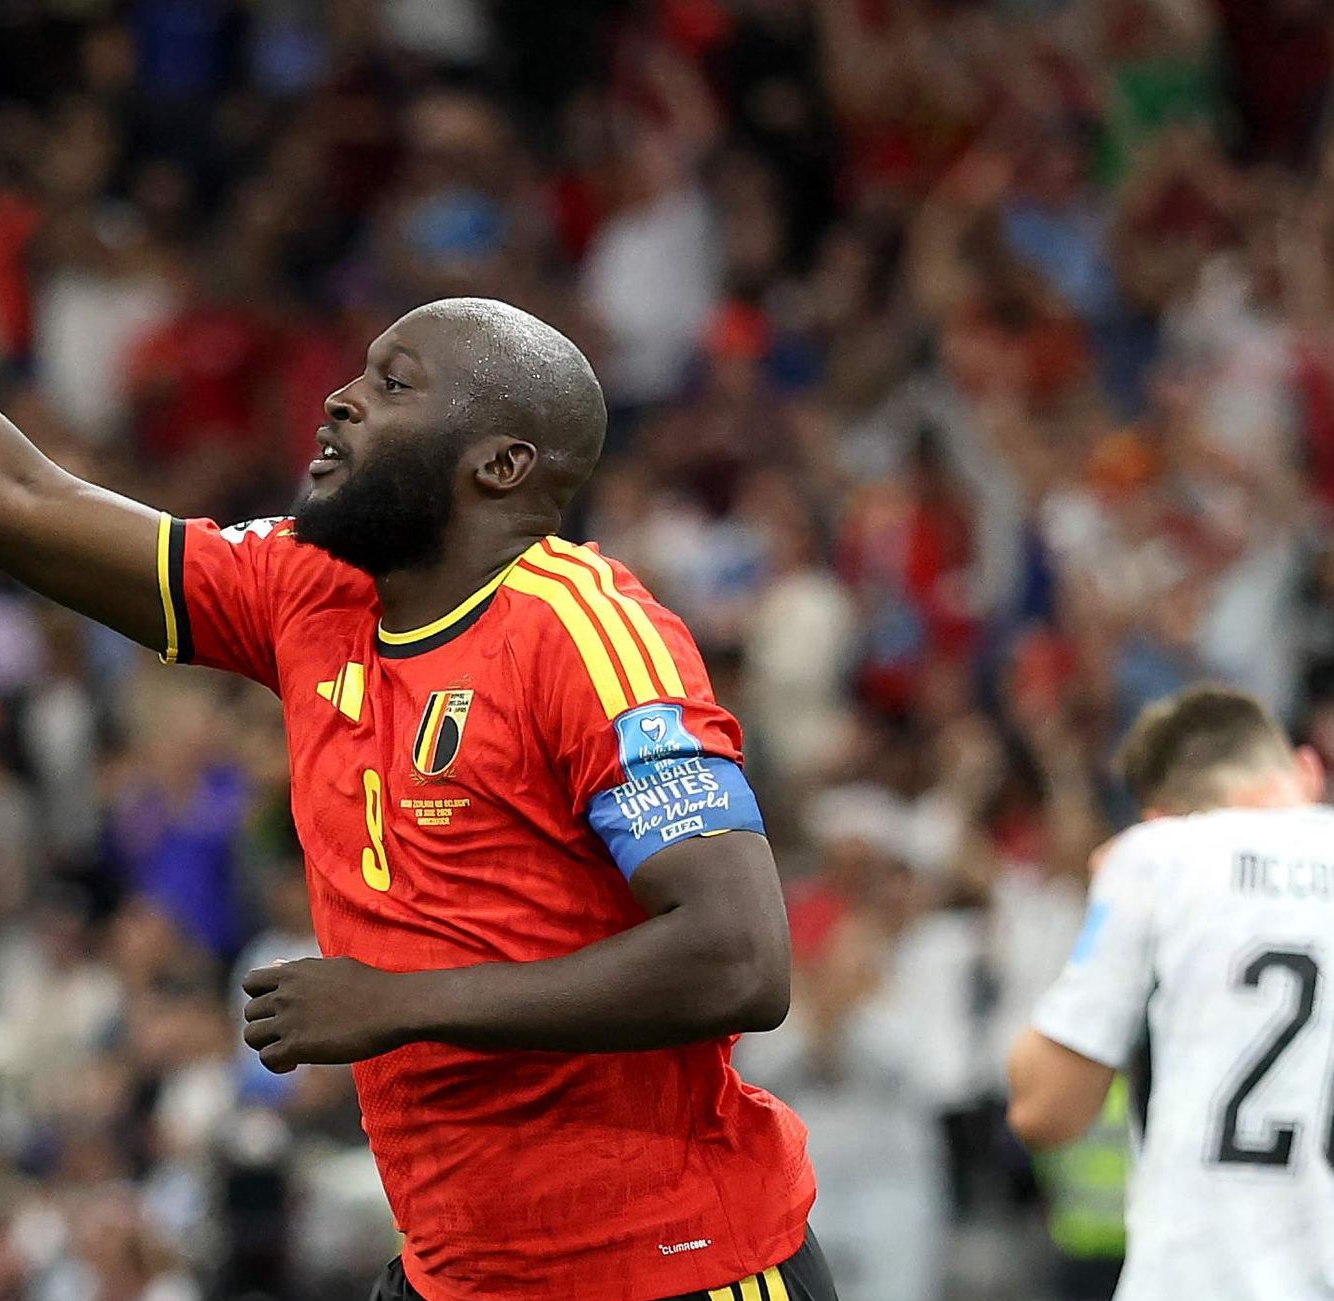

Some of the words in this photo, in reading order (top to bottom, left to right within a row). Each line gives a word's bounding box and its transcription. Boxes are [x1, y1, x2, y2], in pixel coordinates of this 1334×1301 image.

[620, 772, 719, 819] UNITES
[629, 814, 663, 840] the
[663, 791, 729, 821] World
[362, 769, 391, 892] 9
[665, 819, 700, 837] FIFA
